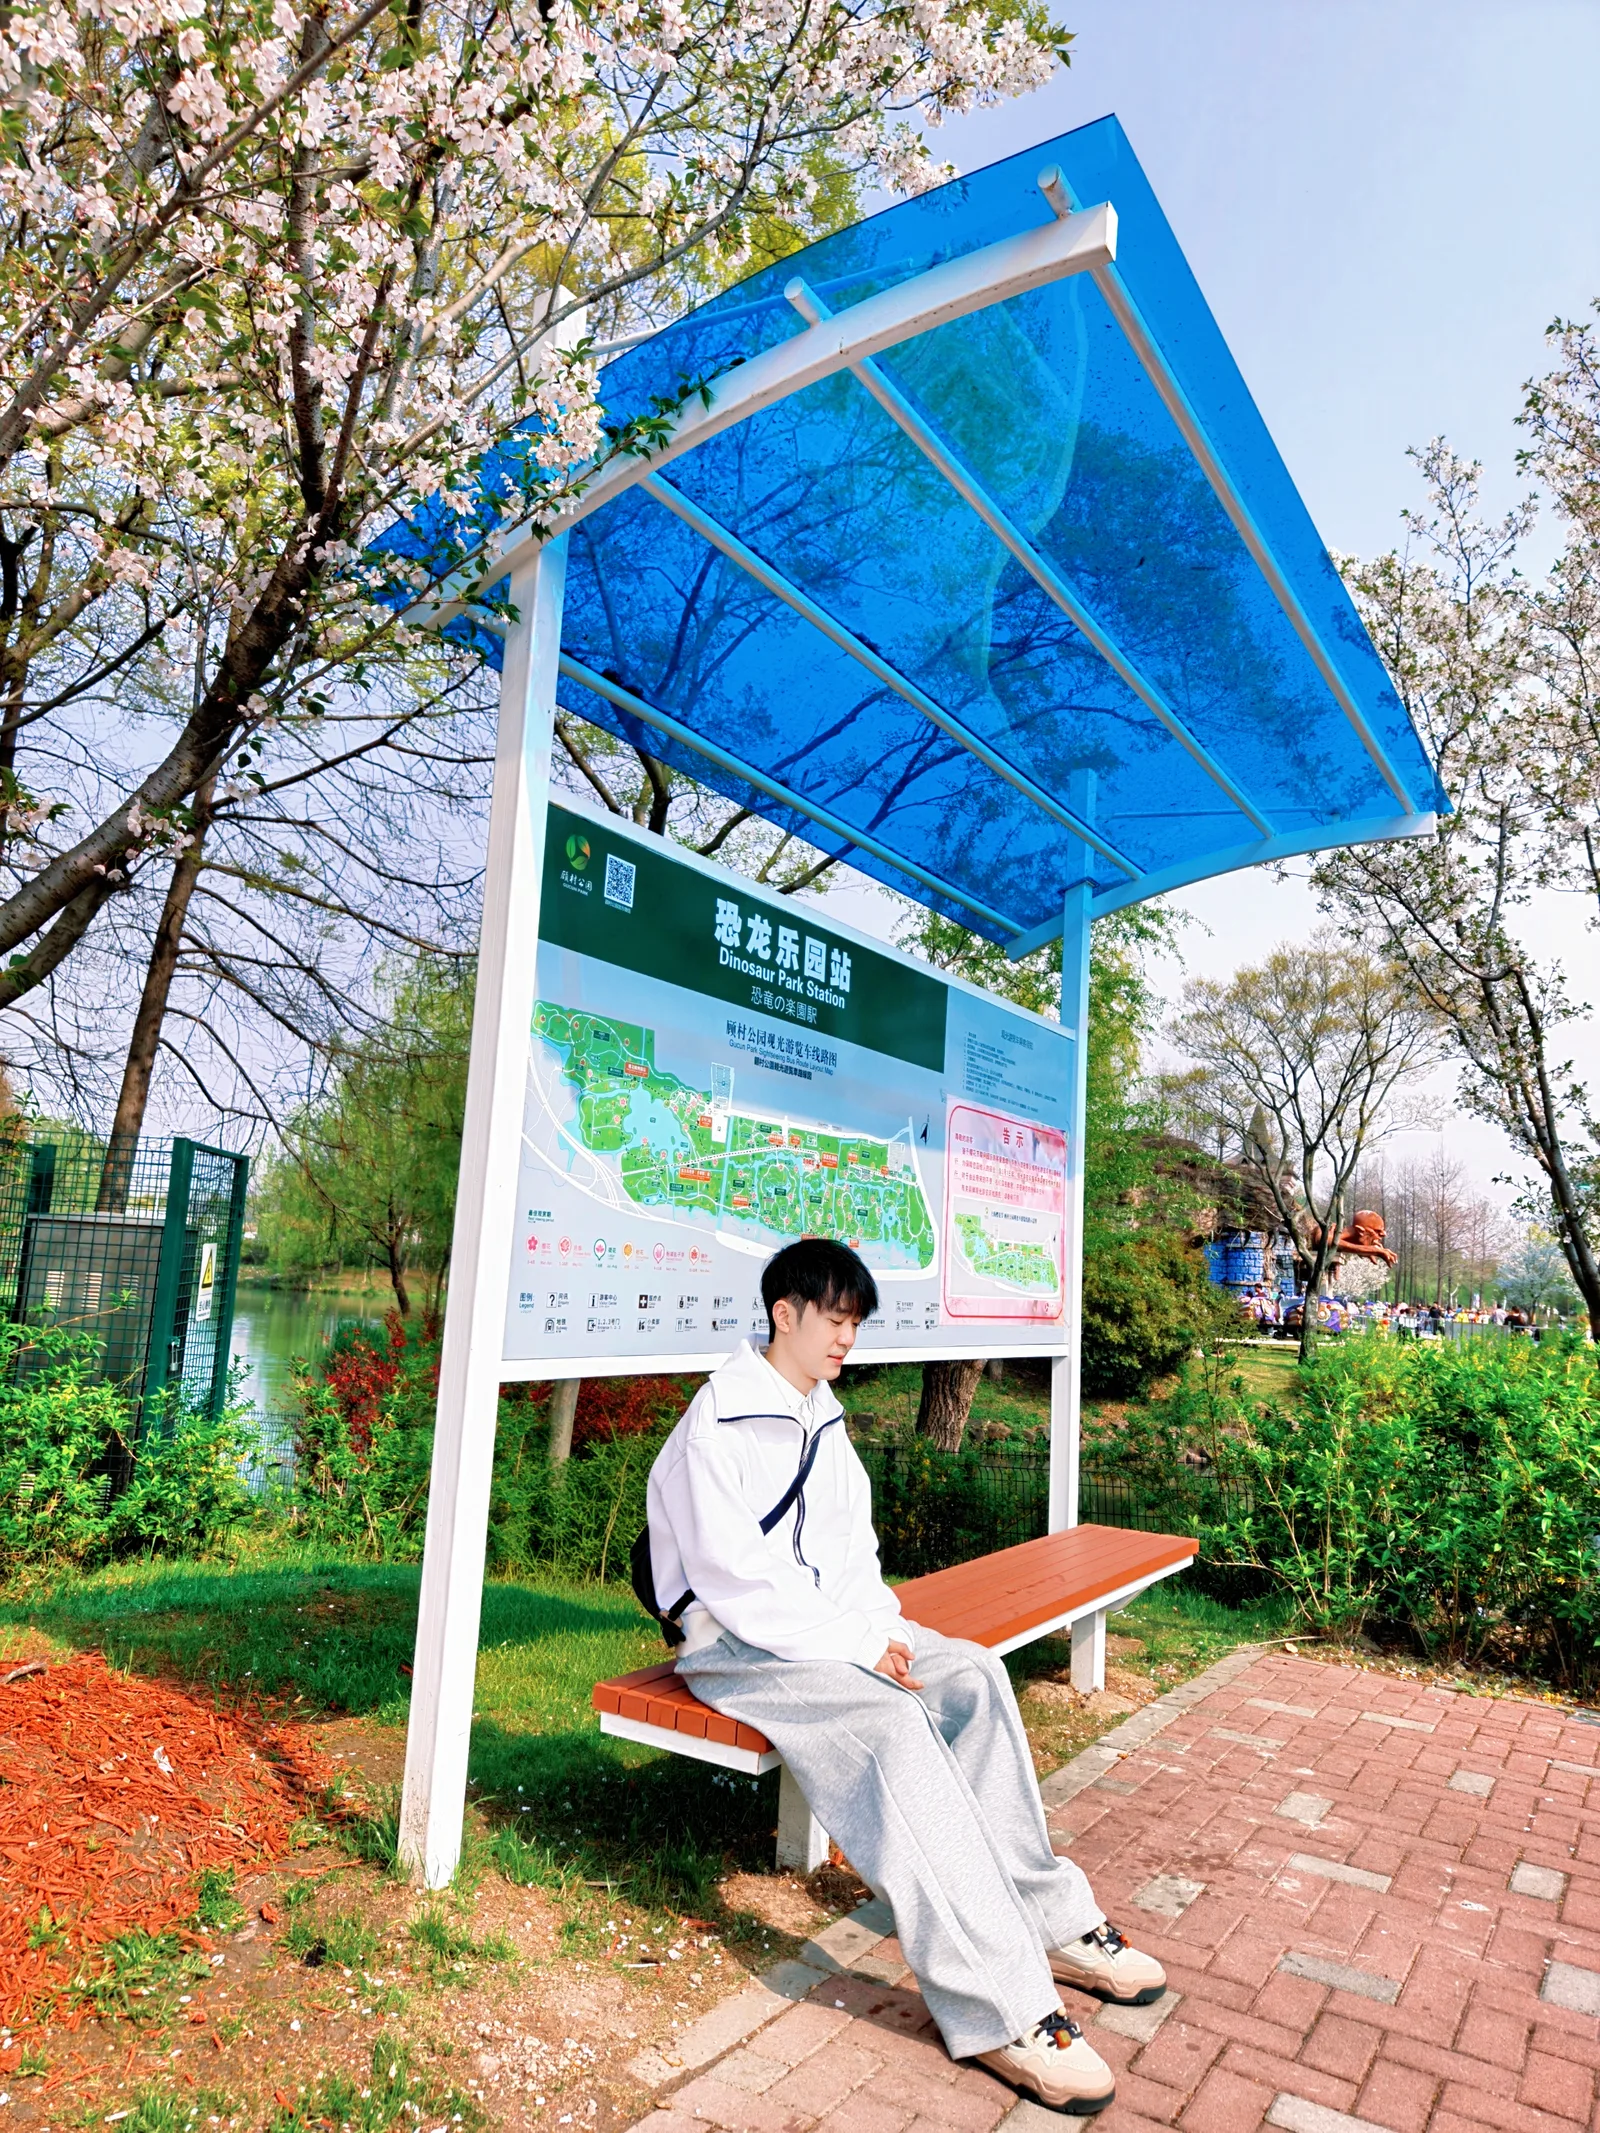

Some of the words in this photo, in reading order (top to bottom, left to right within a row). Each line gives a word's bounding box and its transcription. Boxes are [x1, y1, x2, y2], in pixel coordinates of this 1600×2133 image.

[578, 887, 589, 897] PARK
[714, 897, 852, 993] 恐龙乐园站
[719, 946, 776, 983] Dinosaur
[778, 969, 804, 994] Park
[806, 980, 845, 1009] Station
[751, 985, 818, 1025] 恐竜の楽園駅
[726, 1019, 838, 1068] 顾村公园观光游览车线路图
[729, 1039, 746, 1051] Gucun
[747, 1044, 758, 1054] Park
[759, 1047, 785, 1063] Sightseeing
[786, 1055, 796, 1065] Bus
[796, 1058, 809, 1068] Route
[810, 1062, 824, 1074] Layout
[825, 1066, 834, 1077] Map
